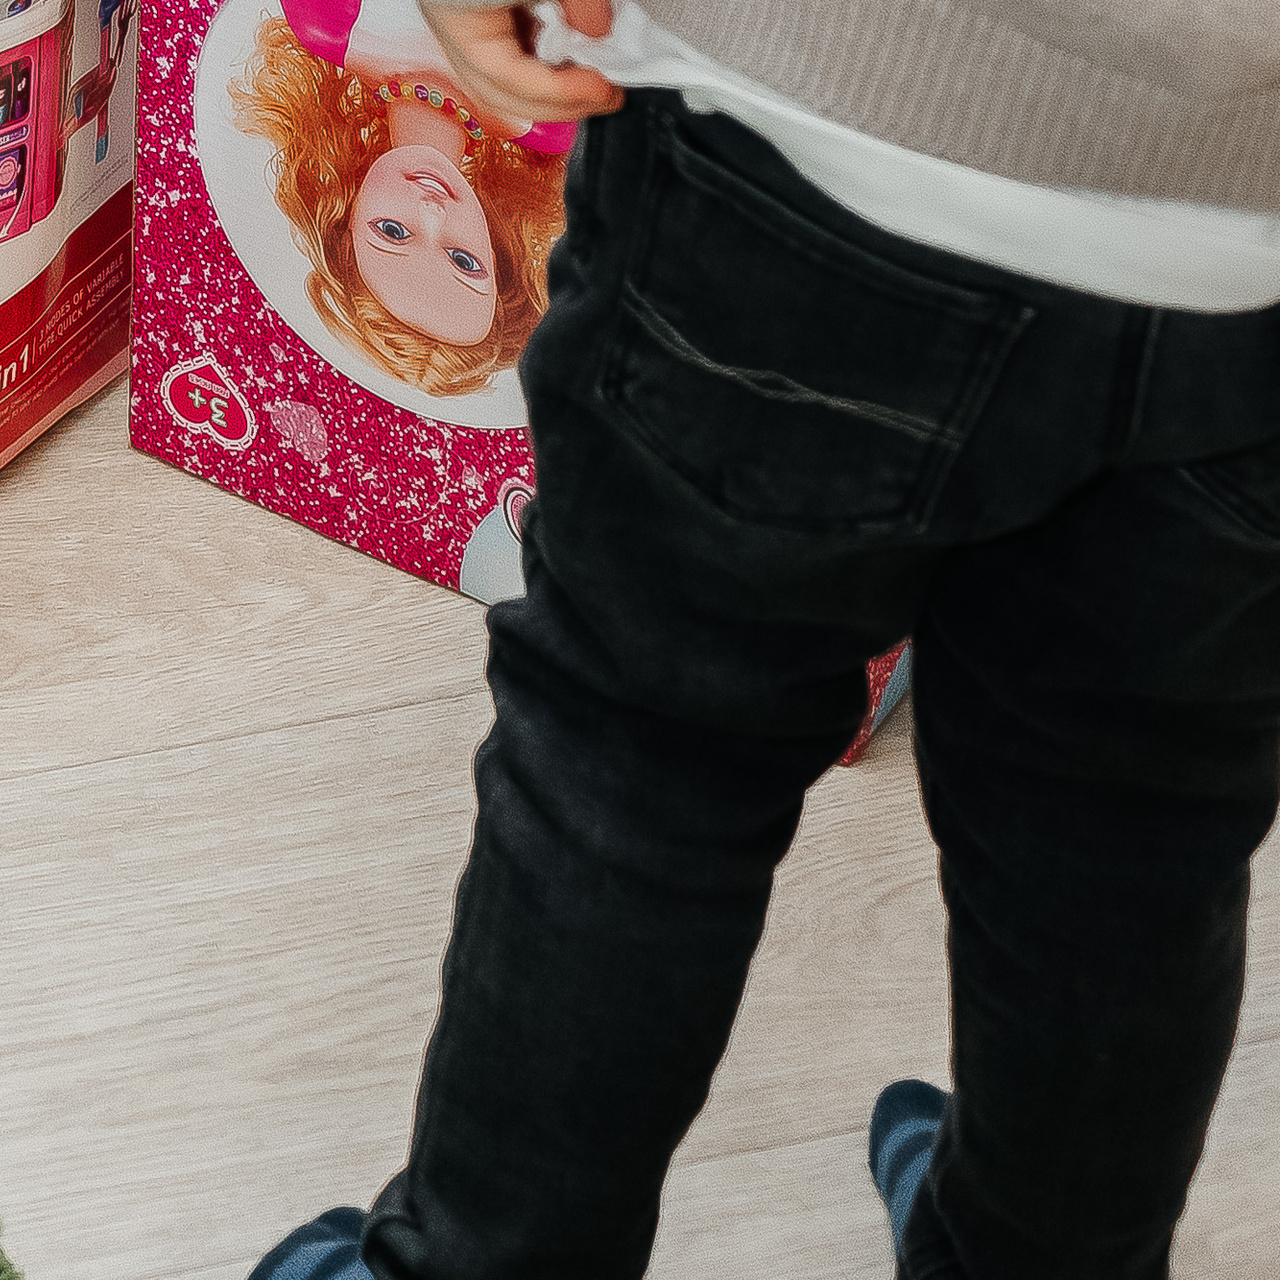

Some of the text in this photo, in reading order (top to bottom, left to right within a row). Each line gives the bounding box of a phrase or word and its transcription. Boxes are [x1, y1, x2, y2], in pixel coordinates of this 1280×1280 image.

[45, 301, 71, 337] MODES
[72, 288, 85, 306] OF
[187, 388, 229, 428] 3+
